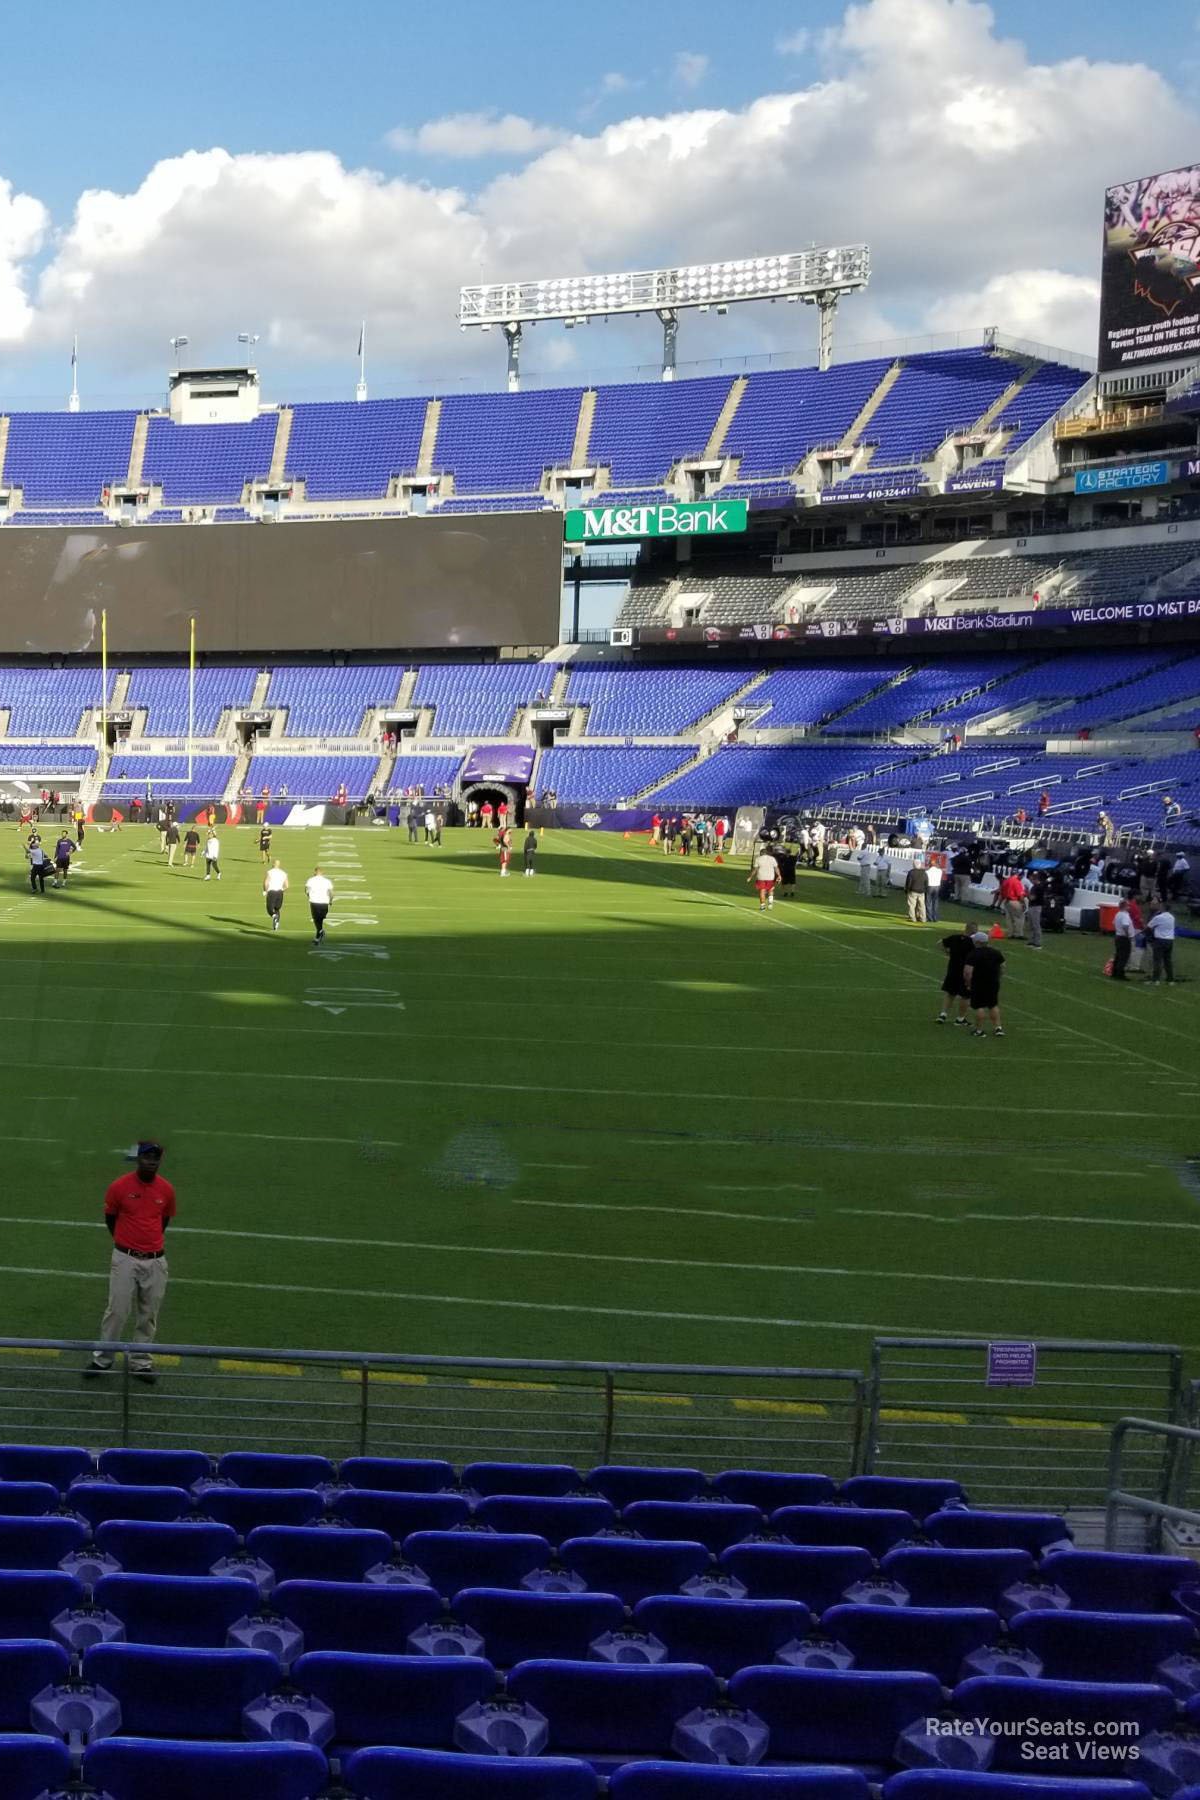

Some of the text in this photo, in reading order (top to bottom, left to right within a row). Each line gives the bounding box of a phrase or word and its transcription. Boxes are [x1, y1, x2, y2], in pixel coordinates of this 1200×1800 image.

[1108, 328, 1135, 339] Register
[1136, 325, 1152, 335] your
[1152, 320, 1171, 332] youth
[1111, 326, 1195, 349] Ravens TEAM ON THE RISE
[1098, 464, 1160, 479] STRATEGIC
[1098, 473, 1159, 488] FACTORY
[582, 503, 728, 537] M&T Bank
[1071, 606, 1133, 622] WELCOME
[1136, 604, 1154, 617] TO
[1157, 602, 1185, 616] M&T
[924, 614, 1032, 632] M&T Bank Stadium
